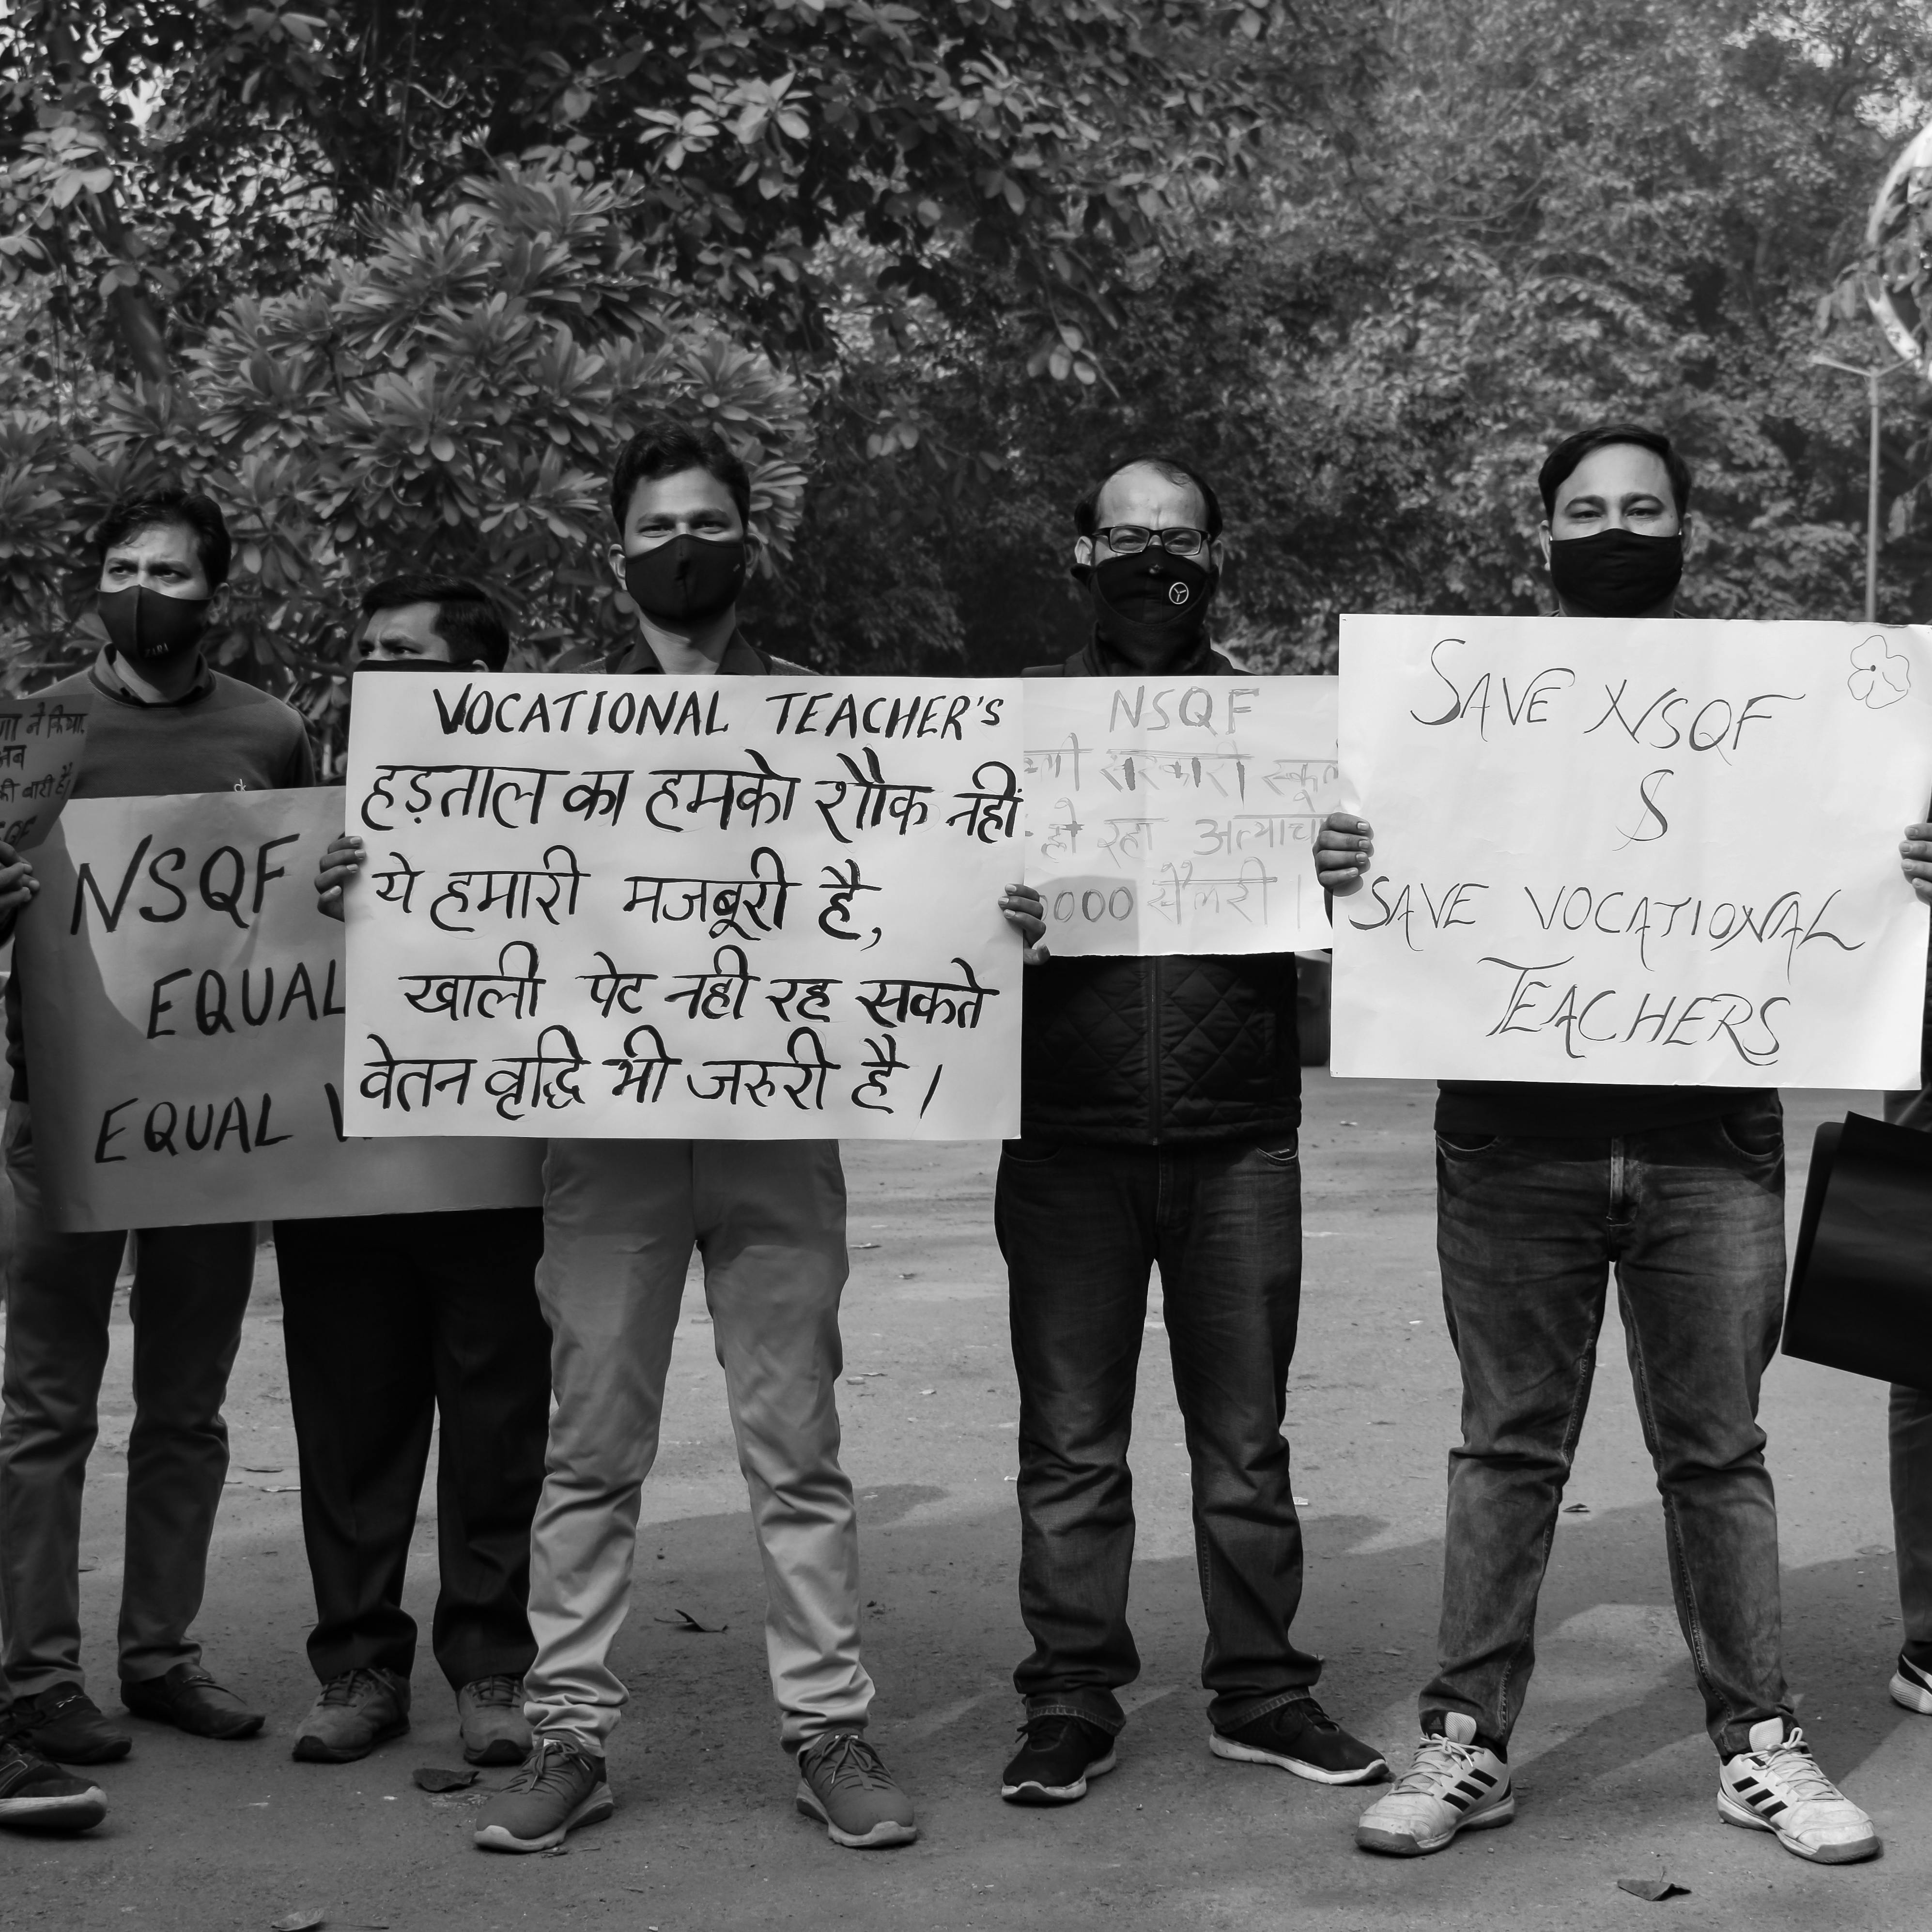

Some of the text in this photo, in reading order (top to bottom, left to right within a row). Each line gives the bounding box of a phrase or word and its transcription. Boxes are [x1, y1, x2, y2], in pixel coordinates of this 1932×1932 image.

[433, 684, 1004, 740] VOCATIONAL TEACHER'S
[1110, 685, 1260, 737] NSQF
[1410, 638, 1806, 766] SAVE NSQF
[361, 747, 1023, 844] हड़ताल का हमको शौक नहीं
[71, 834, 300, 935] NSQF
[1097, 818, 1169, 869] रहा
[371, 852, 425, 913] ये
[430, 845, 591, 932] हमारी
[623, 847, 803, 941] मजबूरी
[1040, 886, 1134, 922] 000
[1348, 876, 1866, 984] SAVE VOCATIONAL
[147, 959, 345, 1039] EQUAL
[398, 941, 1000, 1028] खाली पेट नही रह सकते
[1477, 956, 1792, 1066] TEACHERS
[360, 1034, 478, 1112] वेतन
[602, 1025, 682, 1103] भी
[95, 1093, 294, 1163] EQUAL
